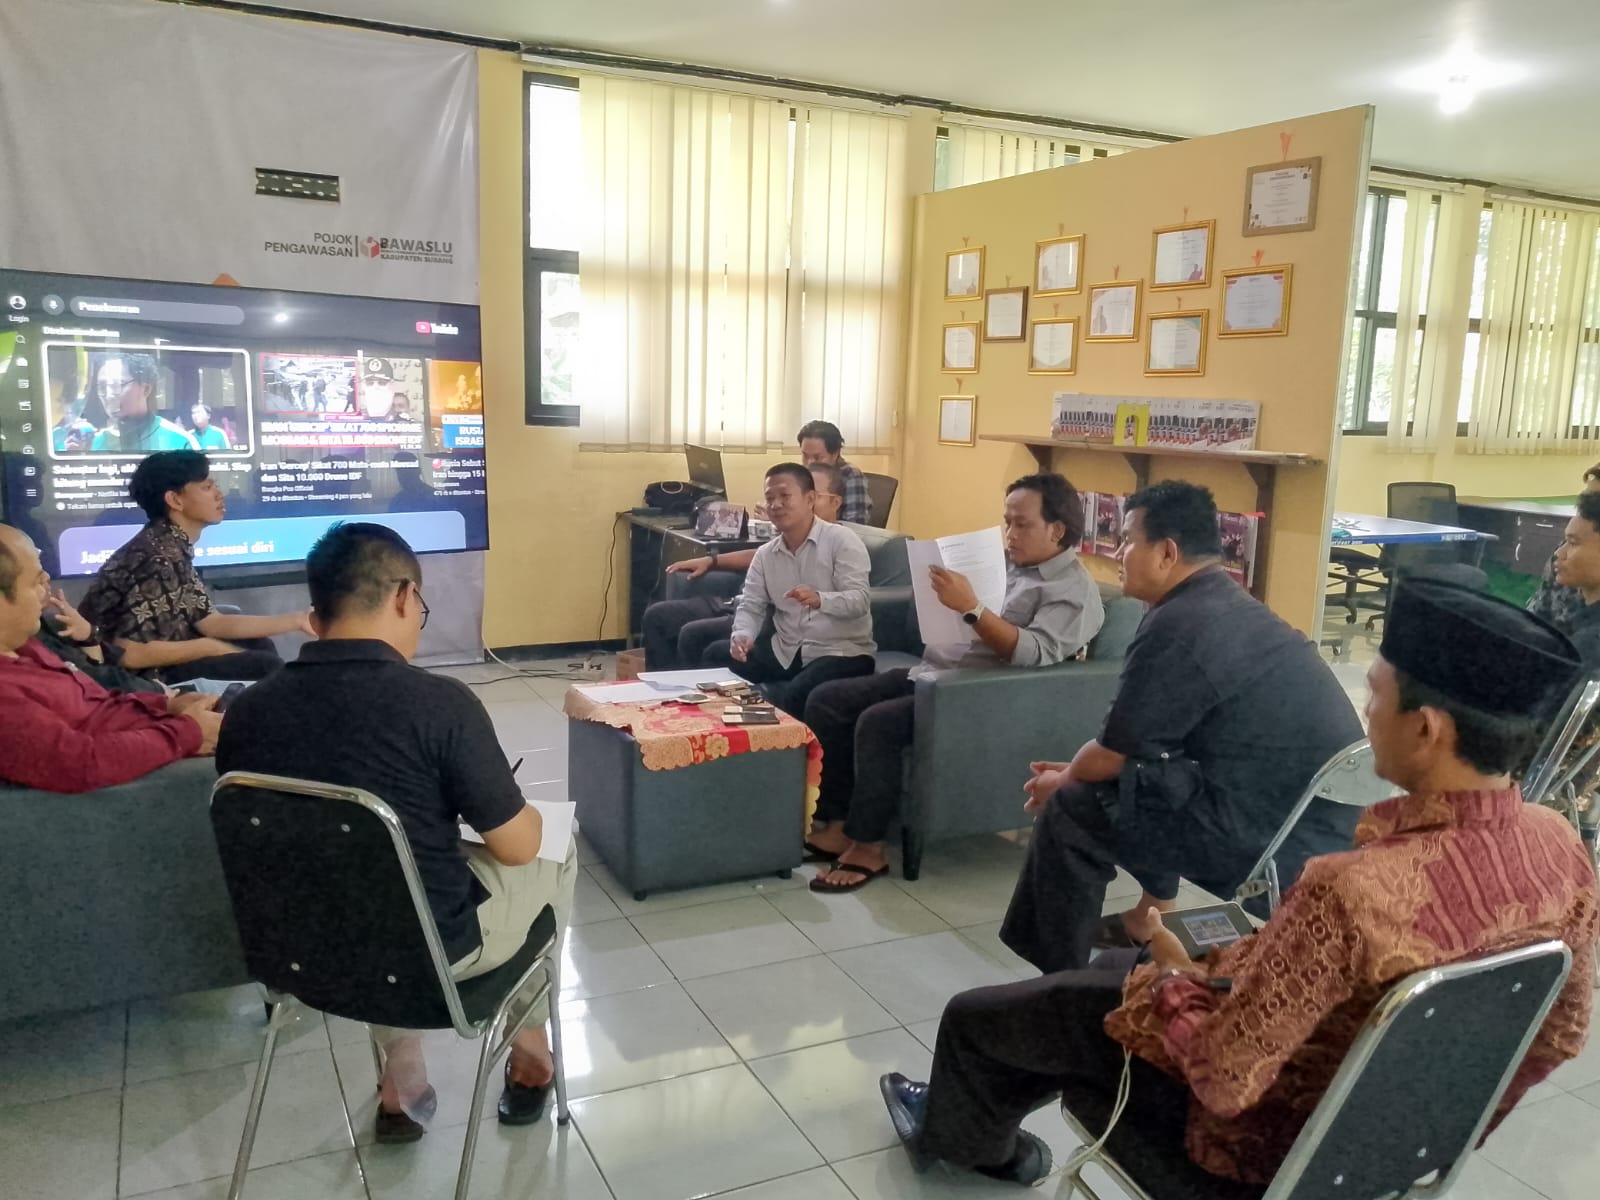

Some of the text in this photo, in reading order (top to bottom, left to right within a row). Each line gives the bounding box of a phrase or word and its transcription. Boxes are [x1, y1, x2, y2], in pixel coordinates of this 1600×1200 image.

[314, 232, 353, 245] POJOK
[380, 238, 453, 255] BAWASLU
[264, 242, 353, 258] PENGAWASAN
[380, 255, 423, 264] KABUPATEN
[206, 541, 248, 556] sesuai
[251, 540, 274, 554] diri
